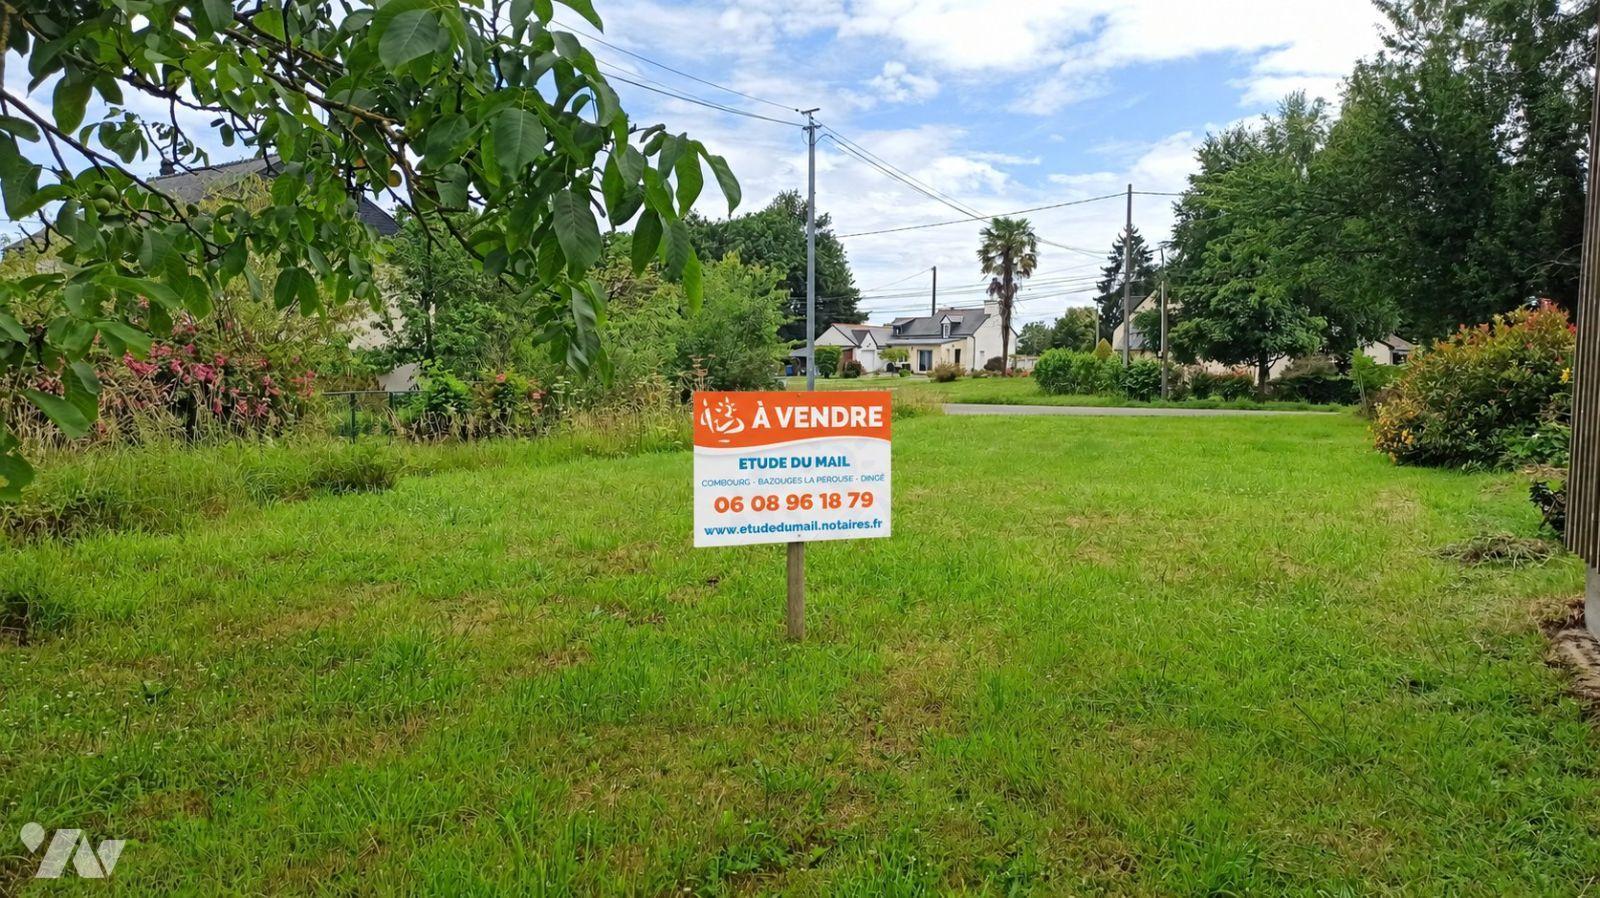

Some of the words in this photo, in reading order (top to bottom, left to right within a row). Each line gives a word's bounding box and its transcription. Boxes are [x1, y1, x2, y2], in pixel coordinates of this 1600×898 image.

[752, 400, 771, 429] À
[775, 406, 883, 428] VENDRE
[739, 457, 787, 469] ETUDE
[791, 457, 811, 468] DU
[816, 456, 850, 467] MAIL
[702, 478, 750, 487] COMBOURG
[758, 477, 802, 485] BAZOUGES
[861, 473, 885, 481] DINGÉ
[714, 496, 744, 513] 06
[751, 495, 779, 511] 08
[786, 493, 813, 510] 96
[819, 493, 841, 509] 18
[848, 492, 874, 509] 79
[704, 519, 882, 535] www.etudedumail.notaires.fr
